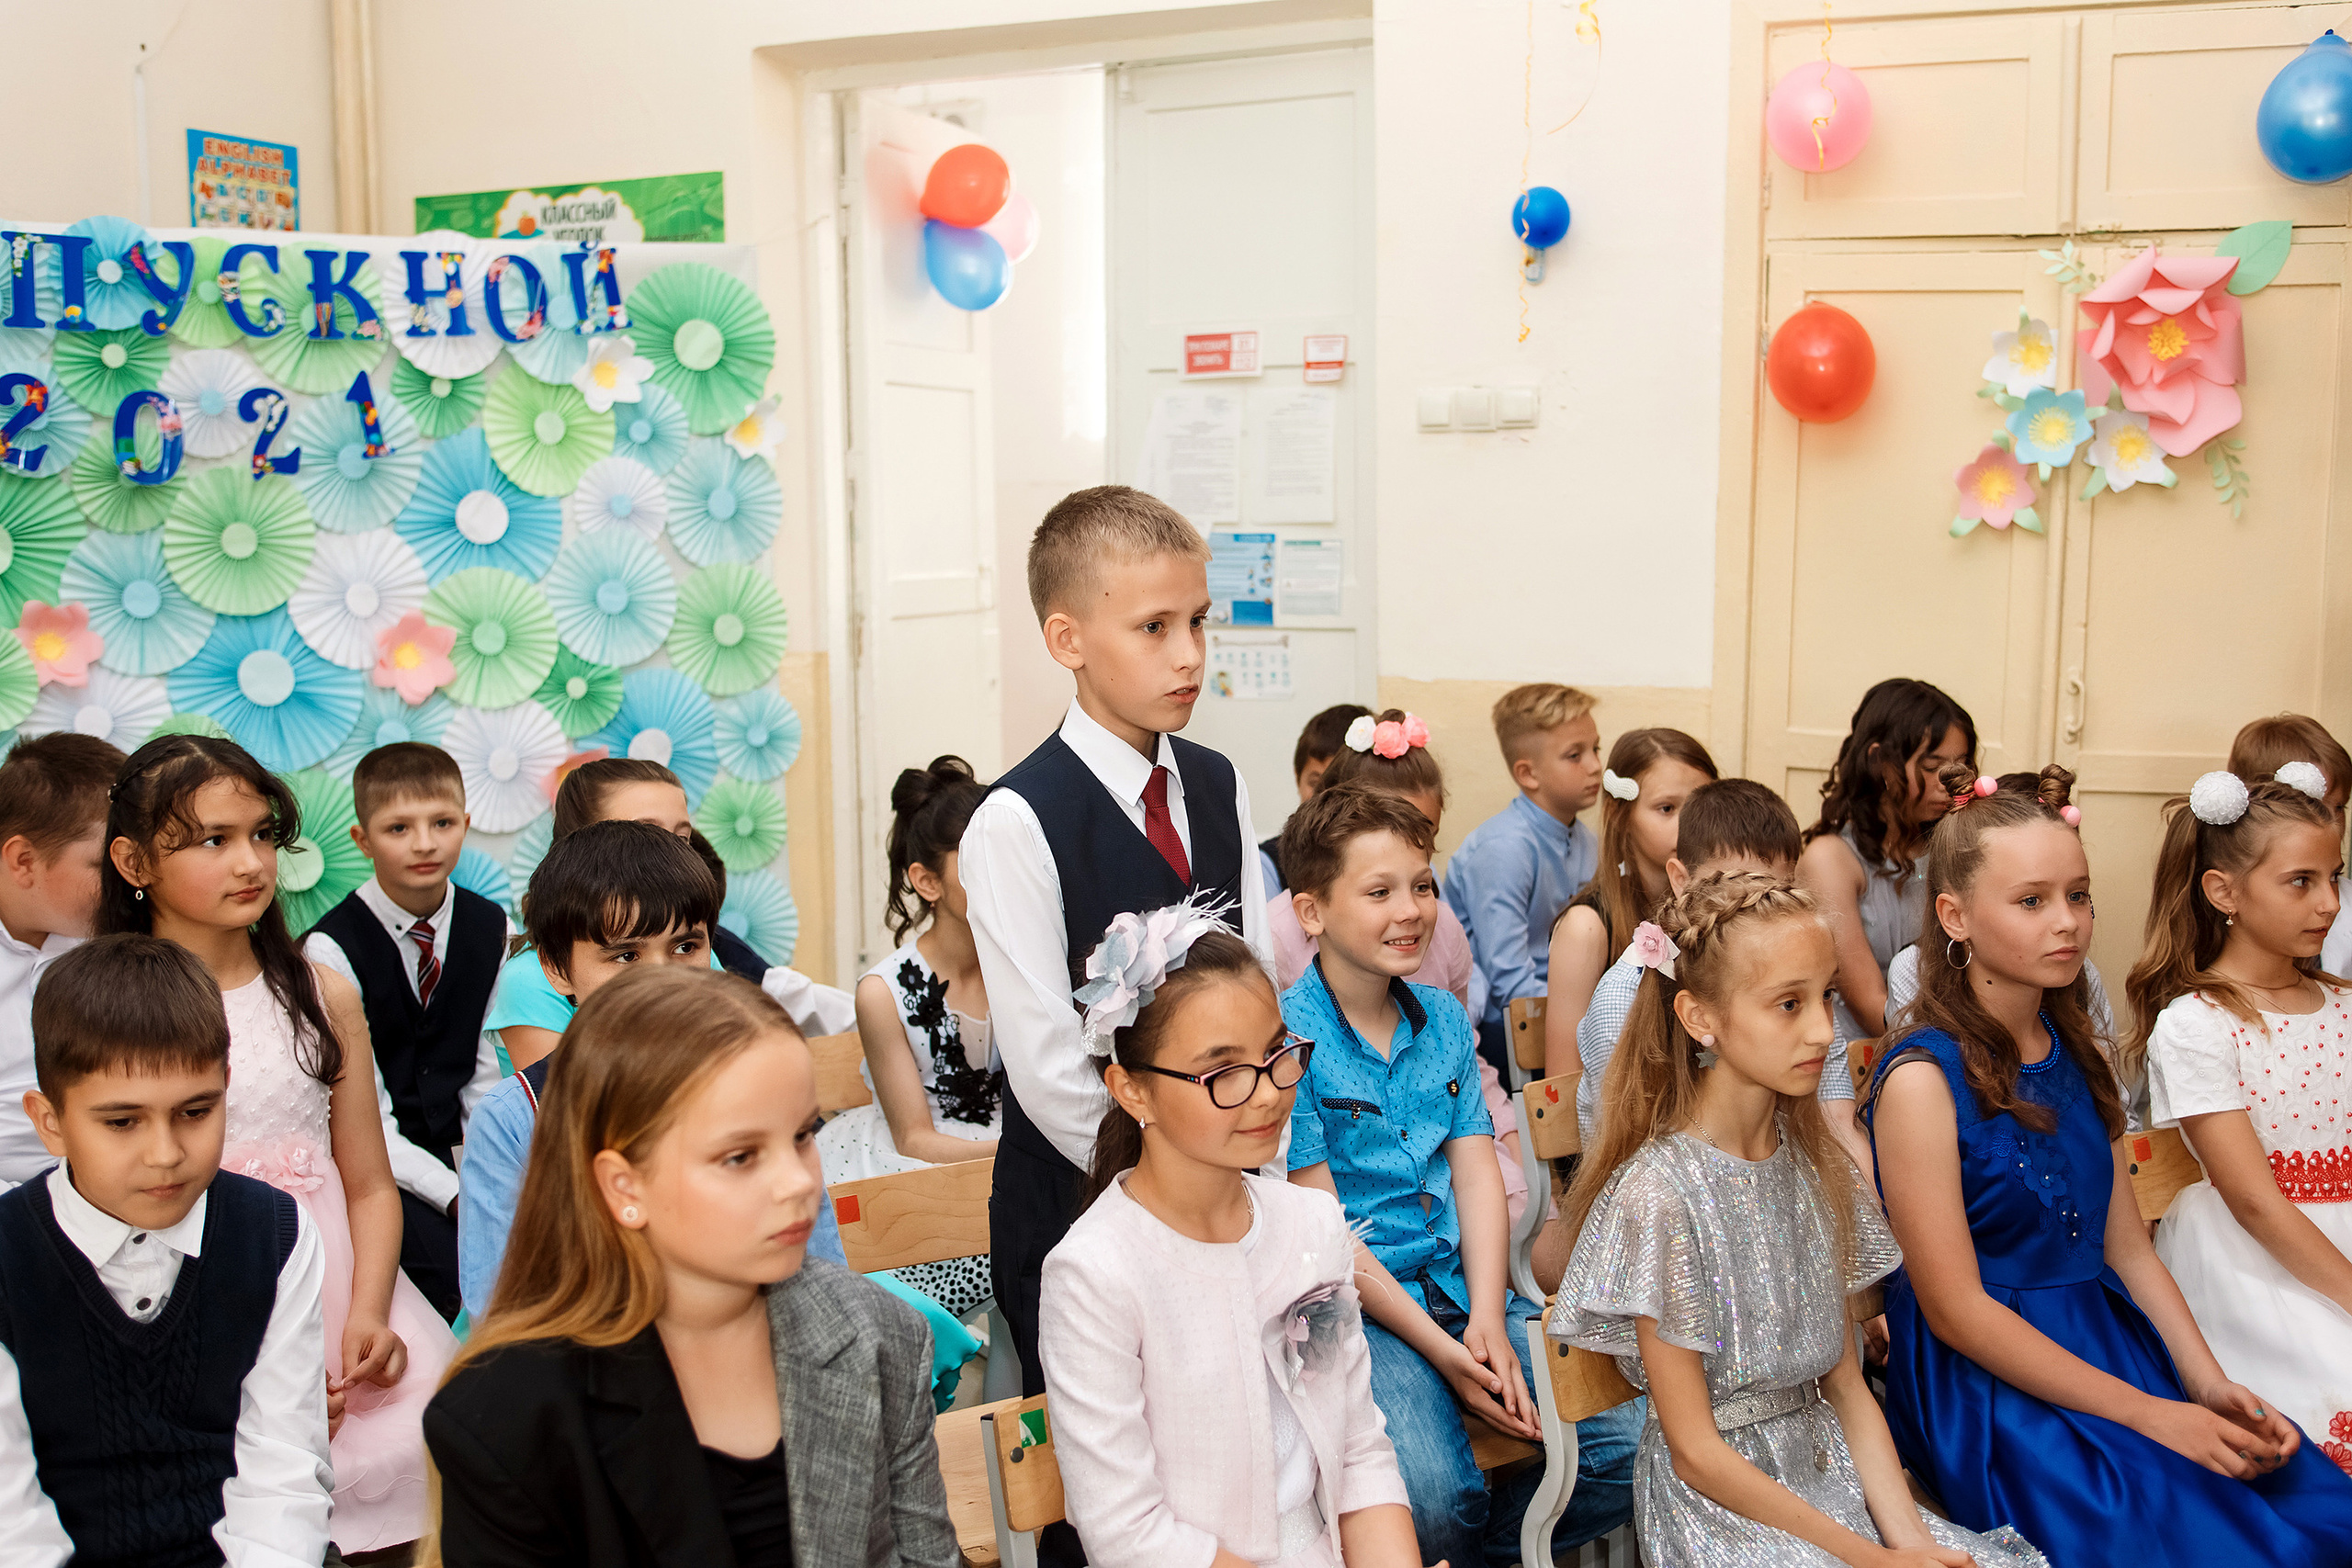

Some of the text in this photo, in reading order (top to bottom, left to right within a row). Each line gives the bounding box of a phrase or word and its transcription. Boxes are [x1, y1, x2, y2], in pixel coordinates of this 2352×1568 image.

[203, 137, 283, 165] ENGLISH
[197, 156, 291, 186] ALPHABET
[540, 197, 616, 225] КЛАССНЫЙ
